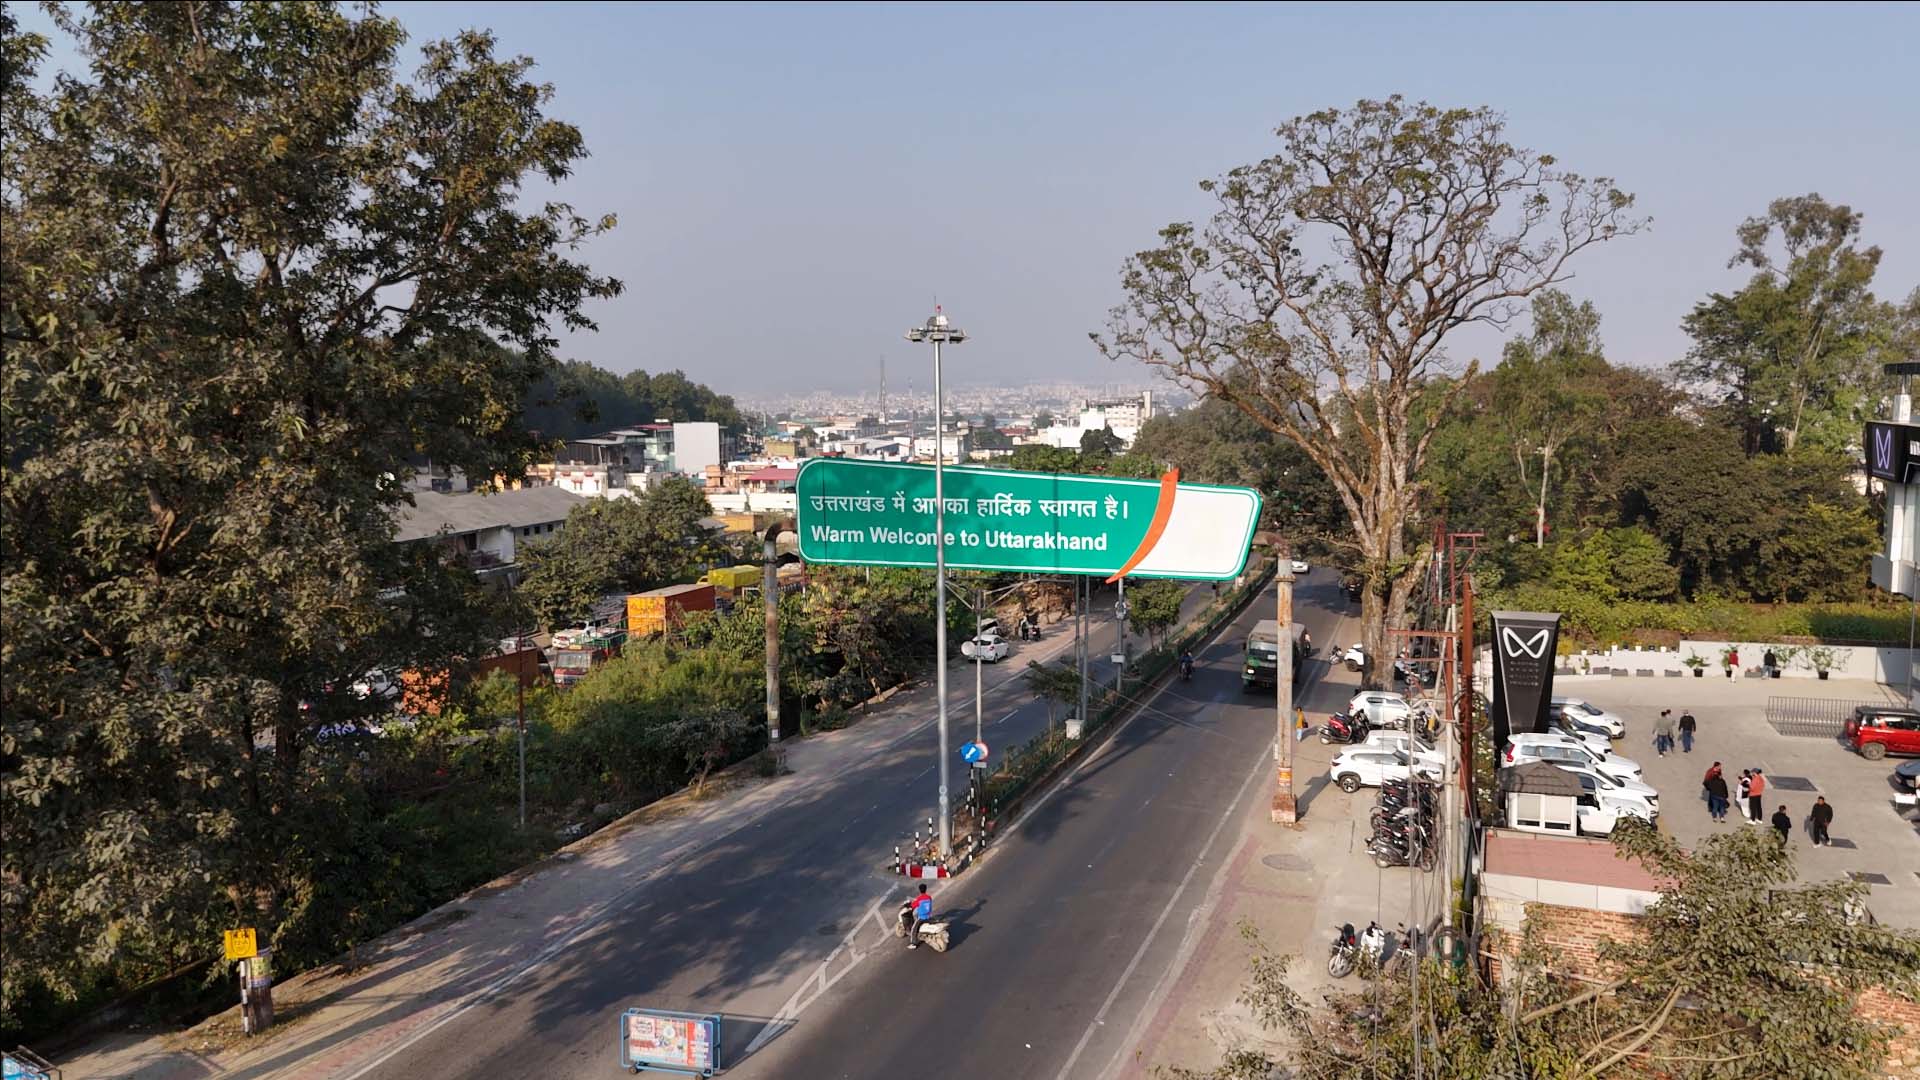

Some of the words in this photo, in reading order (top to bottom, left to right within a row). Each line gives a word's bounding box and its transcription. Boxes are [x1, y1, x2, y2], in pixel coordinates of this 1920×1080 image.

[810, 490, 885, 512] उत्तराखंड
[892, 491, 906, 513] में
[976, 493, 1032, 517] हार्दिक
[1038, 499, 1097, 517] स्वागत
[811, 525, 864, 543] Warm
[869, 526, 955, 546] Welcome
[960, 529, 980, 546] to
[985, 530, 1107, 551] Uttarakhand
